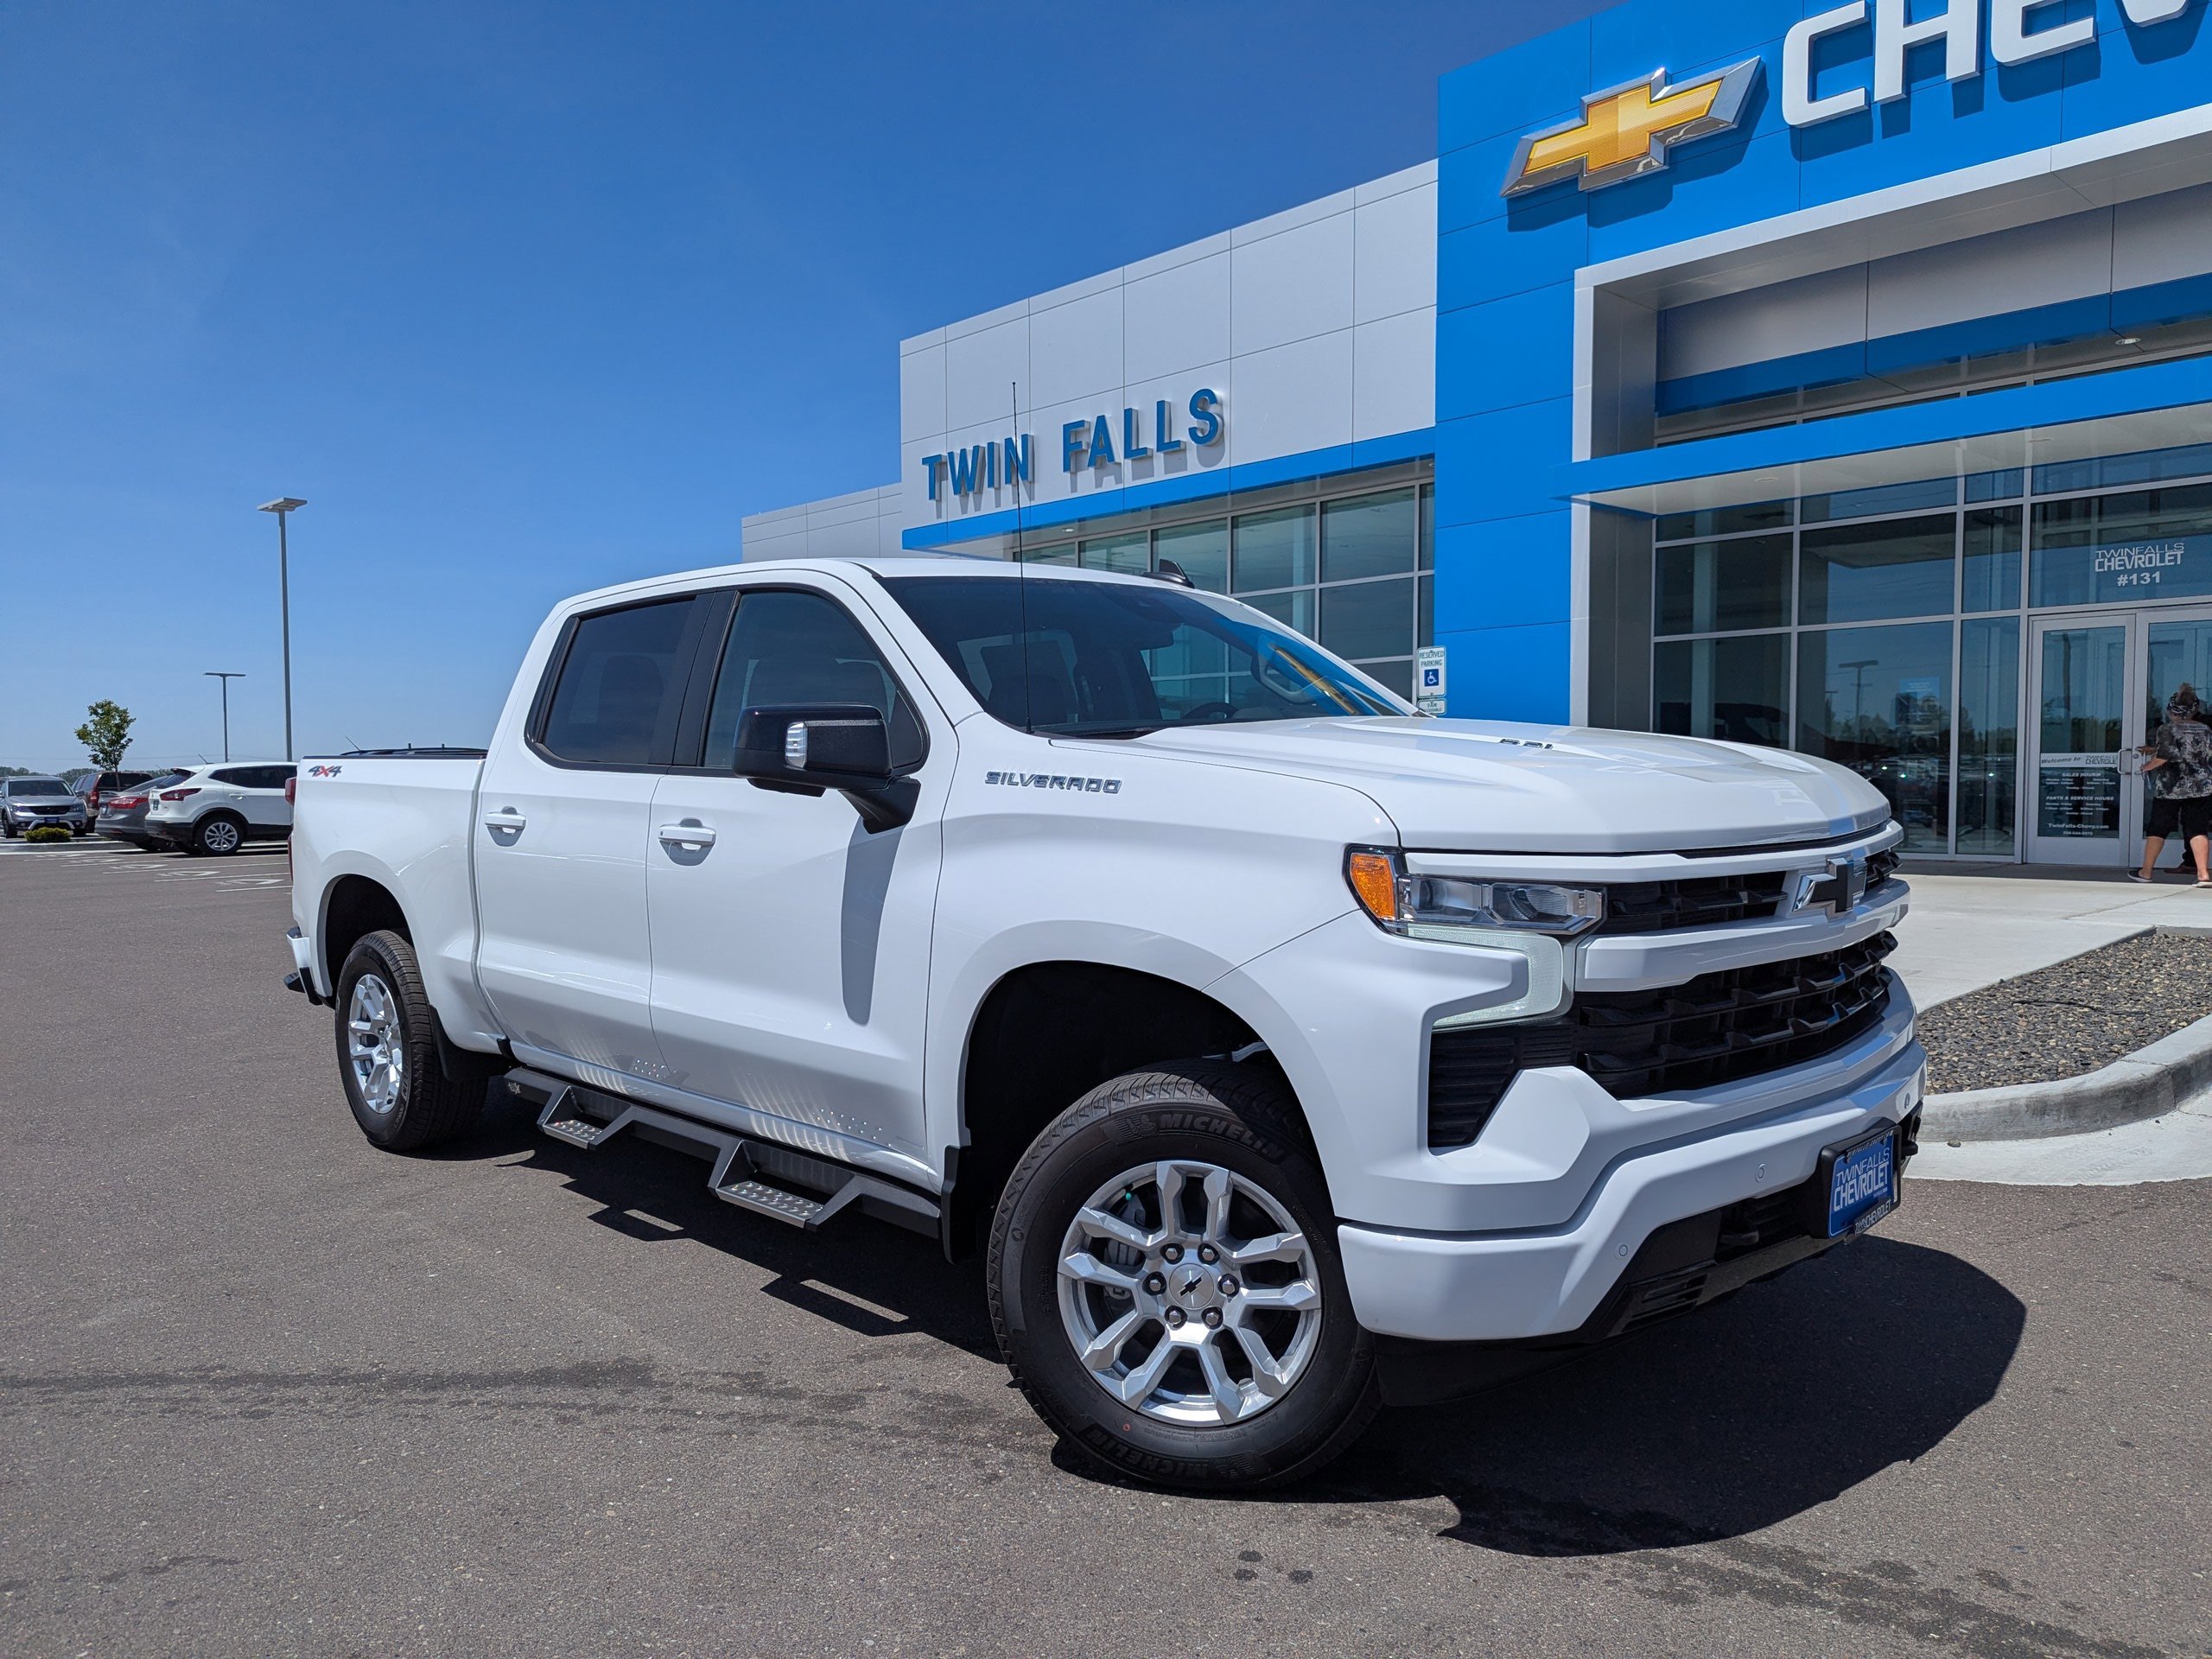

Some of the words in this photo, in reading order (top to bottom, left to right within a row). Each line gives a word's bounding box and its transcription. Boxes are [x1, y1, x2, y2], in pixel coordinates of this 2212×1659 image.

[921, 433, 1034, 501] TWIN
[1062, 388, 1224, 474] FALLS
[2094, 550, 2184, 572] CHEVROLET
[2095, 542, 2184, 559] TWINFALLS
[2117, 570, 2161, 587] #131
[984, 771, 1123, 794] SILVERADO
[1160, 1113, 1285, 1160] MICHELIN
[1833, 1160, 1890, 1211] CHEVROLET
[1836, 1147, 1891, 1186] TWINFALLS
[1084, 1427, 1209, 1478] MICHELIN
